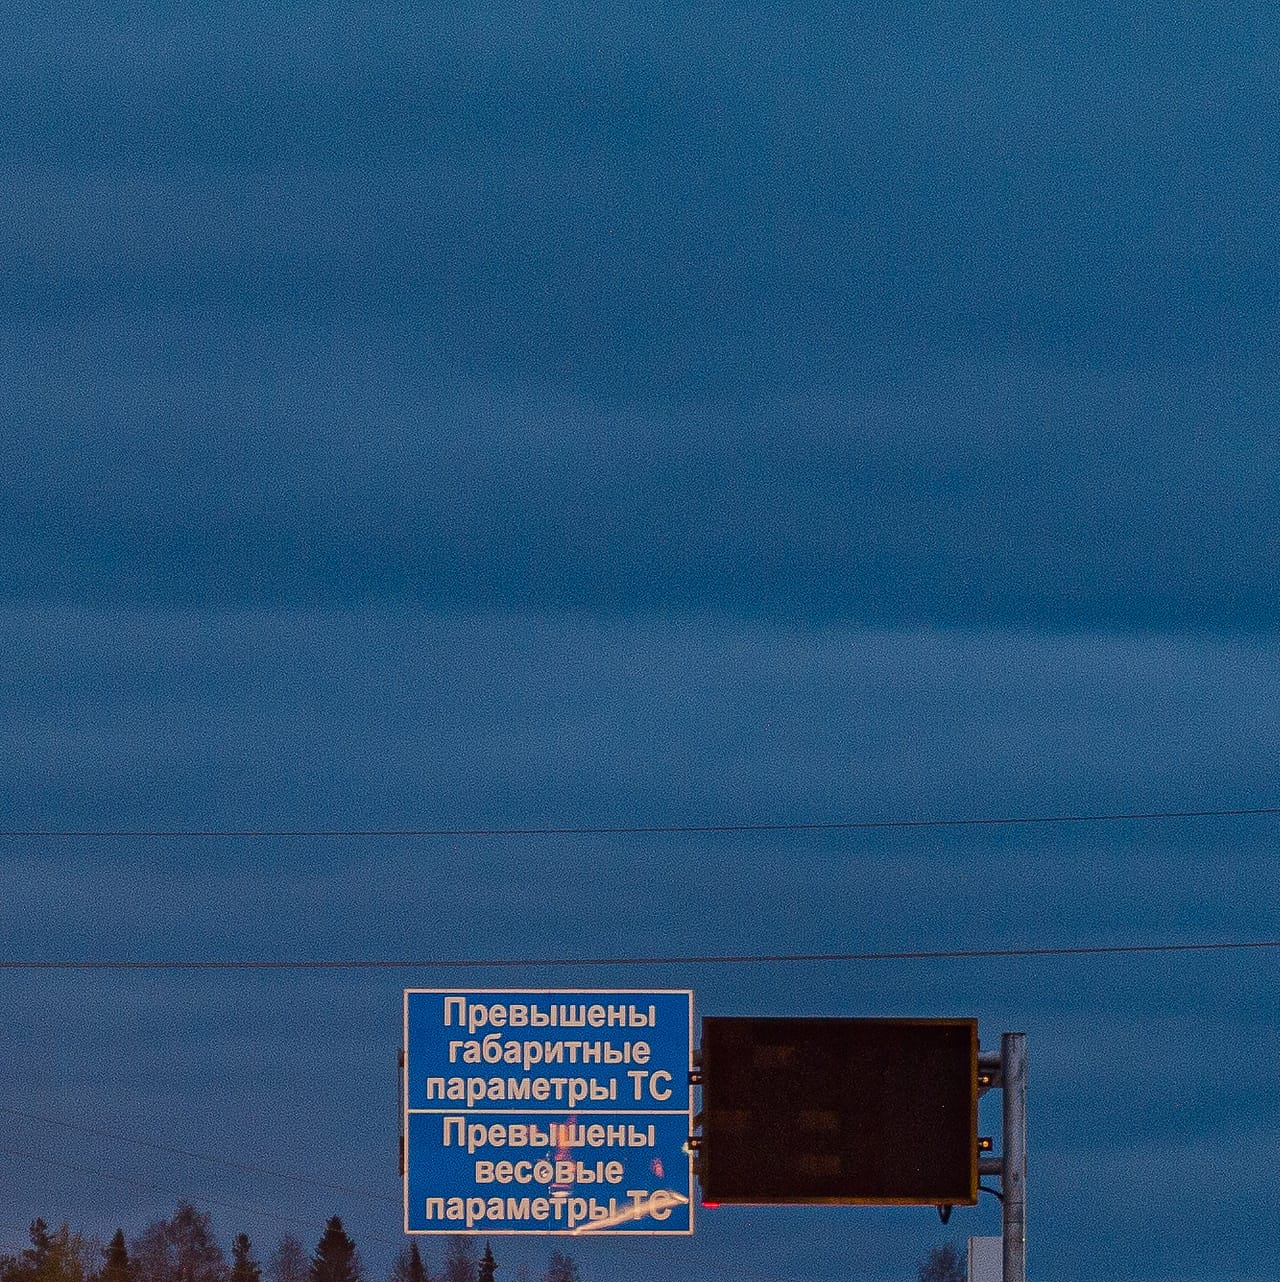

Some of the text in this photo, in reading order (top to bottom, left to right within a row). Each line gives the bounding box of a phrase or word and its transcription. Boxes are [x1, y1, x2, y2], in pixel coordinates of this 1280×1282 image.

[443, 997, 656, 1033] Превышены
[448, 1033, 652, 1070] габаритные
[426, 1070, 673, 1108] параметры ТС
[442, 1117, 655, 1153] Превышены
[475, 1160, 623, 1184] весовые
[426, 1191, 673, 1228] параметры ТС
